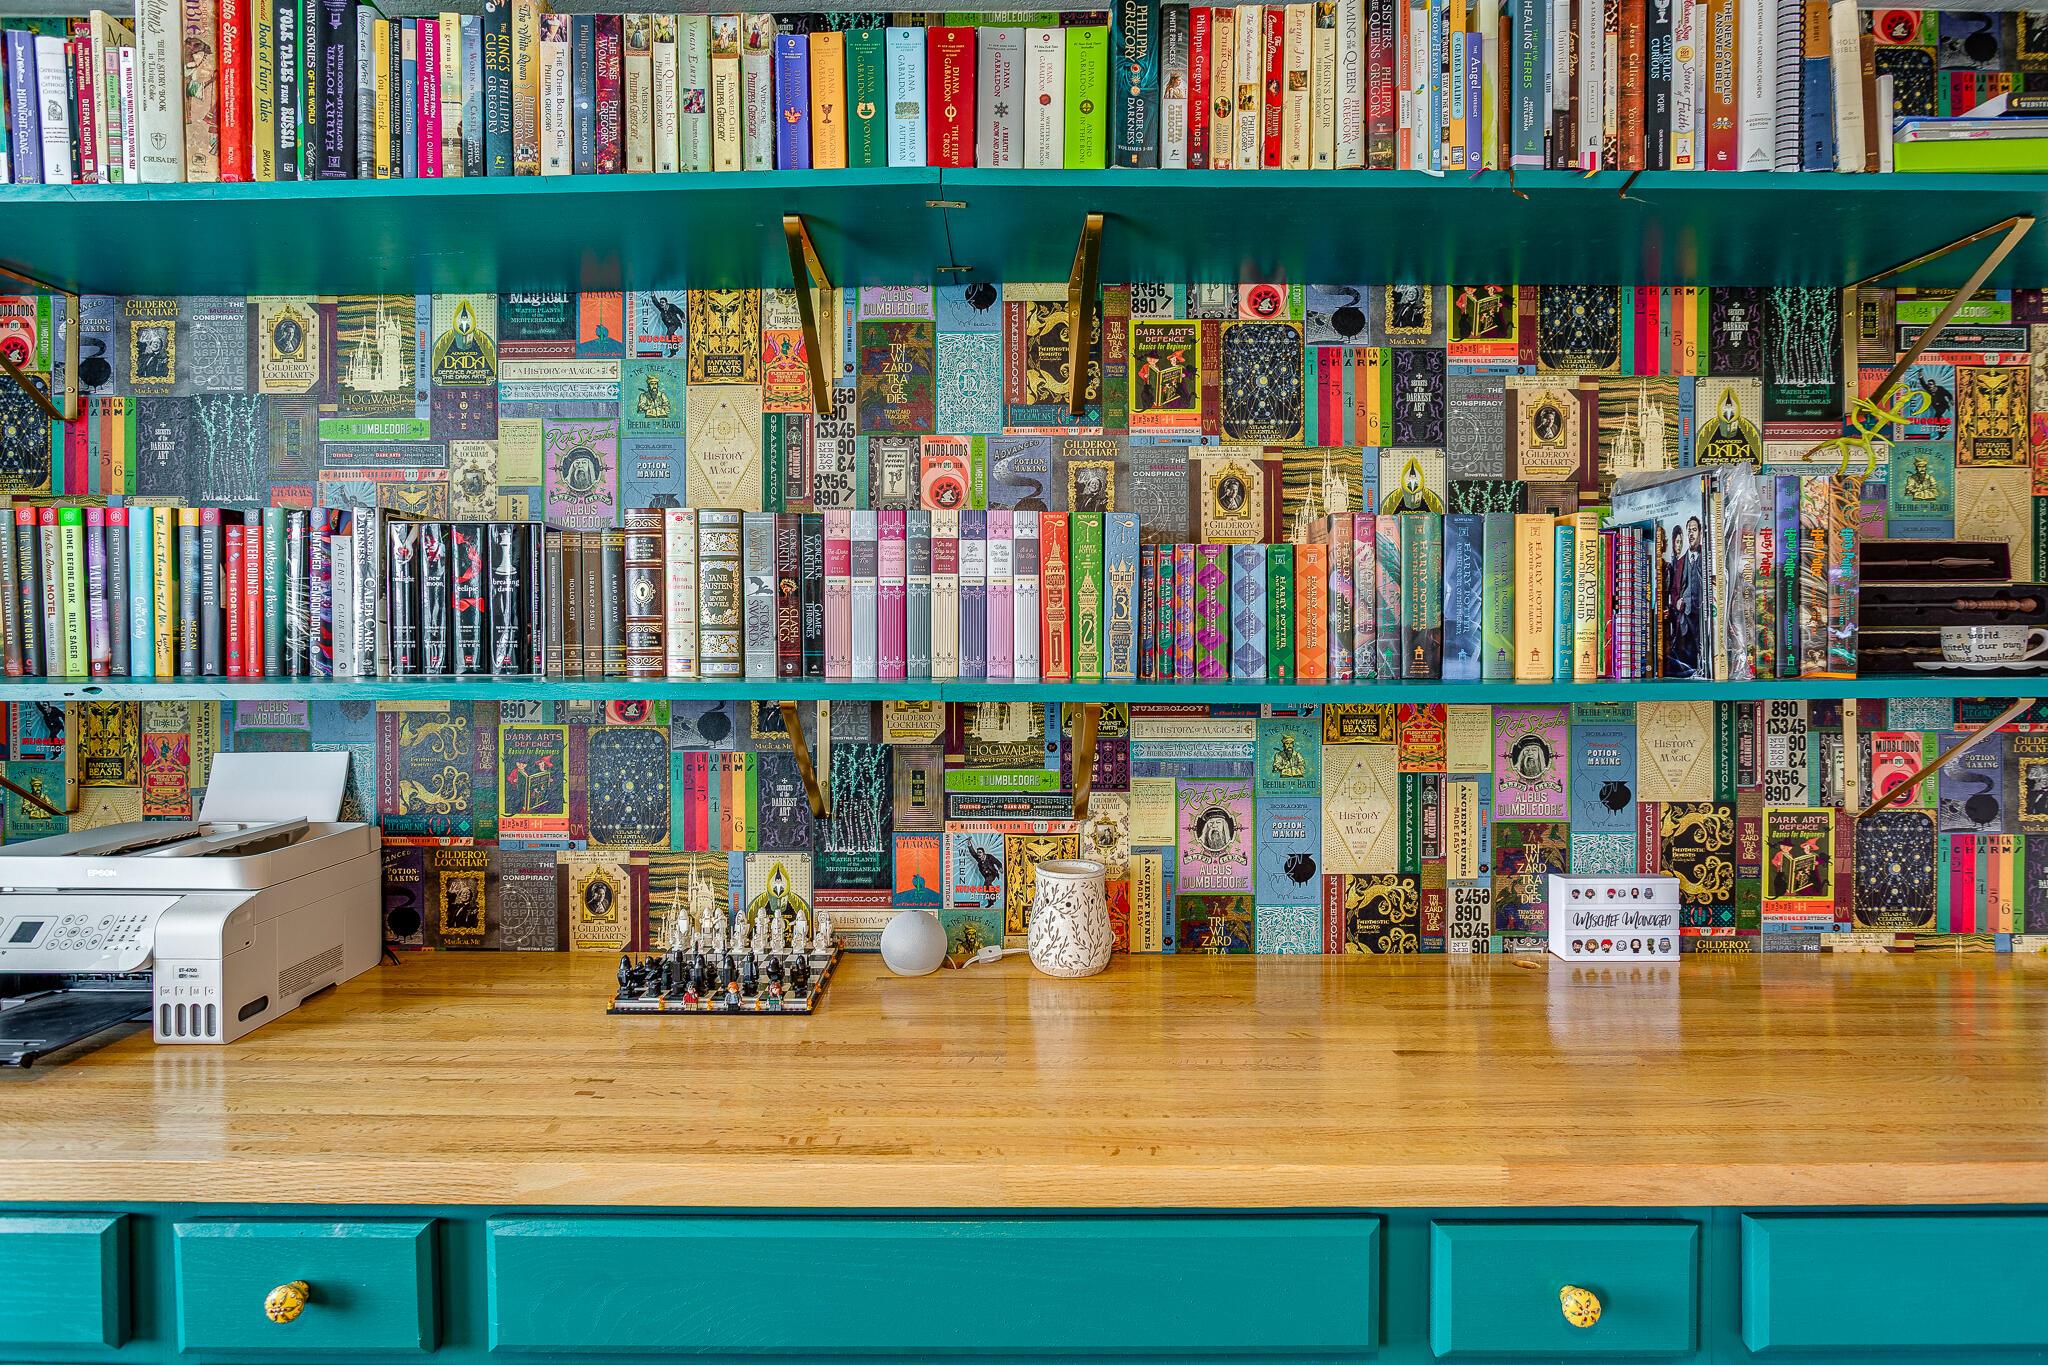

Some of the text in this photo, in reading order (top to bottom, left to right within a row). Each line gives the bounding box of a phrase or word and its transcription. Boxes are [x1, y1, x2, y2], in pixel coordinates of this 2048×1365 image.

[1124, 0, 1148, 62] PHILIPPA GREGORY
[223, 24, 237, 64] Stories
[307, 25, 315, 69] STORIES
[424, 23, 433, 72] BRIDGERTON
[444, 34, 452, 58] german
[486, 33, 496, 70] CURSE
[1524, 1, 1532, 88] HEALING HERBS
[599, 38, 607, 77] WOMAN
[1196, 14, 1205, 93] Philippa Gregory
[1663, 35, 1671, 81] CATHOLIC
[280, 8, 294, 149] FOLK TALES RUSSIA
[944, 58, 952, 103] GABALDON
[1346, 50, 1357, 94] QUEEN
[1470, 58, 1480, 89] Angel
[1723, 51, 1732, 104] CATHOLIC
[1370, 64, 1392, 119] PHILIPPA GREGORY
[488, 75, 508, 135] PHILIPPA GREGORY
[82, 98, 91, 155] DEEPAK CHOPRA
[426, 120, 434, 138] JULIA
[600, 101, 608, 149] GREGORY
[1127, 97, 1135, 144] DARKNESS
[1351, 100, 1359, 142] PHILIPPA
[1628, 107, 1636, 136] YOUNG
[143, 156, 177, 164] CRUSADE
[127, 300, 177, 309] GILDEROY
[509, 292, 569, 306] Magical
[880, 293, 912, 301] ALBUS
[125, 309, 182, 317] LOCKHART
[864, 304, 928, 315] DUMBLEDORE
[639, 335, 682, 343] MUGGLES
[1011, 303, 1019, 396] NUMEROLOGY
[443, 355, 486, 369] DADA
[708, 365, 741, 373] BEASTS
[883, 364, 912, 372] ZARD
[1774, 375, 1835, 386] Magical
[342, 394, 410, 404] HOGWARTS
[887, 394, 907, 403] DIES
[1406, 393, 1432, 401] DARKEST
[1414, 402, 1425, 412] ART
[925, 444, 968, 456] MUDBLOODS
[1063, 448, 1119, 457] LOCKHART
[1065, 440, 1117, 448] GILDEROY
[1708, 443, 1750, 457] DADA
[1976, 448, 2010, 456] BEASTS
[704, 452, 744, 460] HISTORY
[1521, 458, 1575, 466] LOCKHART'S
[637, 470, 670, 478] MAKING
[709, 466, 740, 474] MAGIC
[247, 528, 258, 560] WINTER
[357, 511, 366, 564] DARKNESS
[779, 528, 789, 572] MARTIN
[805, 535, 814, 580] MARTIN
[336, 544, 345, 594] ALIENIST
[205, 564, 213, 606] MARRIAGE
[247, 564, 258, 595] COUNTS
[311, 532, 321, 642] UNTAMED GLENNON DOYLE
[704, 582, 732, 590] AUSTEN
[1586, 539, 1596, 622] HARRY POTTER
[48, 586, 56, 618] MOTEL
[90, 566, 102, 621] VALENTINE
[364, 578, 374, 652] CALEB CARR
[1116, 596, 1128, 618] 3
[23, 599, 32, 649] ALEX NORTH
[780, 607, 789, 642] KINGS
[806, 601, 814, 640] THRONES
[1968, 632, 2000, 640] world
[1875, 741, 1919, 753] MUDBLOODS
[89, 768, 122, 776] BEASTS
[1263, 779, 1315, 788] BEEDLE BARD
[1339, 812, 1380, 820] HISTORY
[1345, 826, 1375, 834] MAGIC
[896, 841, 939, 849] CHARMS
[434, 859, 490, 867] LOCKHART
[436, 851, 488, 860] GILDEROY
[1199, 866, 1232, 875] ALBUS
[1517, 864, 1546, 873] ZARD
[956, 885, 1000, 893] MUGGLES
[1183, 877, 1246, 888] DUMBLEDORE
[840, 916, 876, 924] HISTORY
